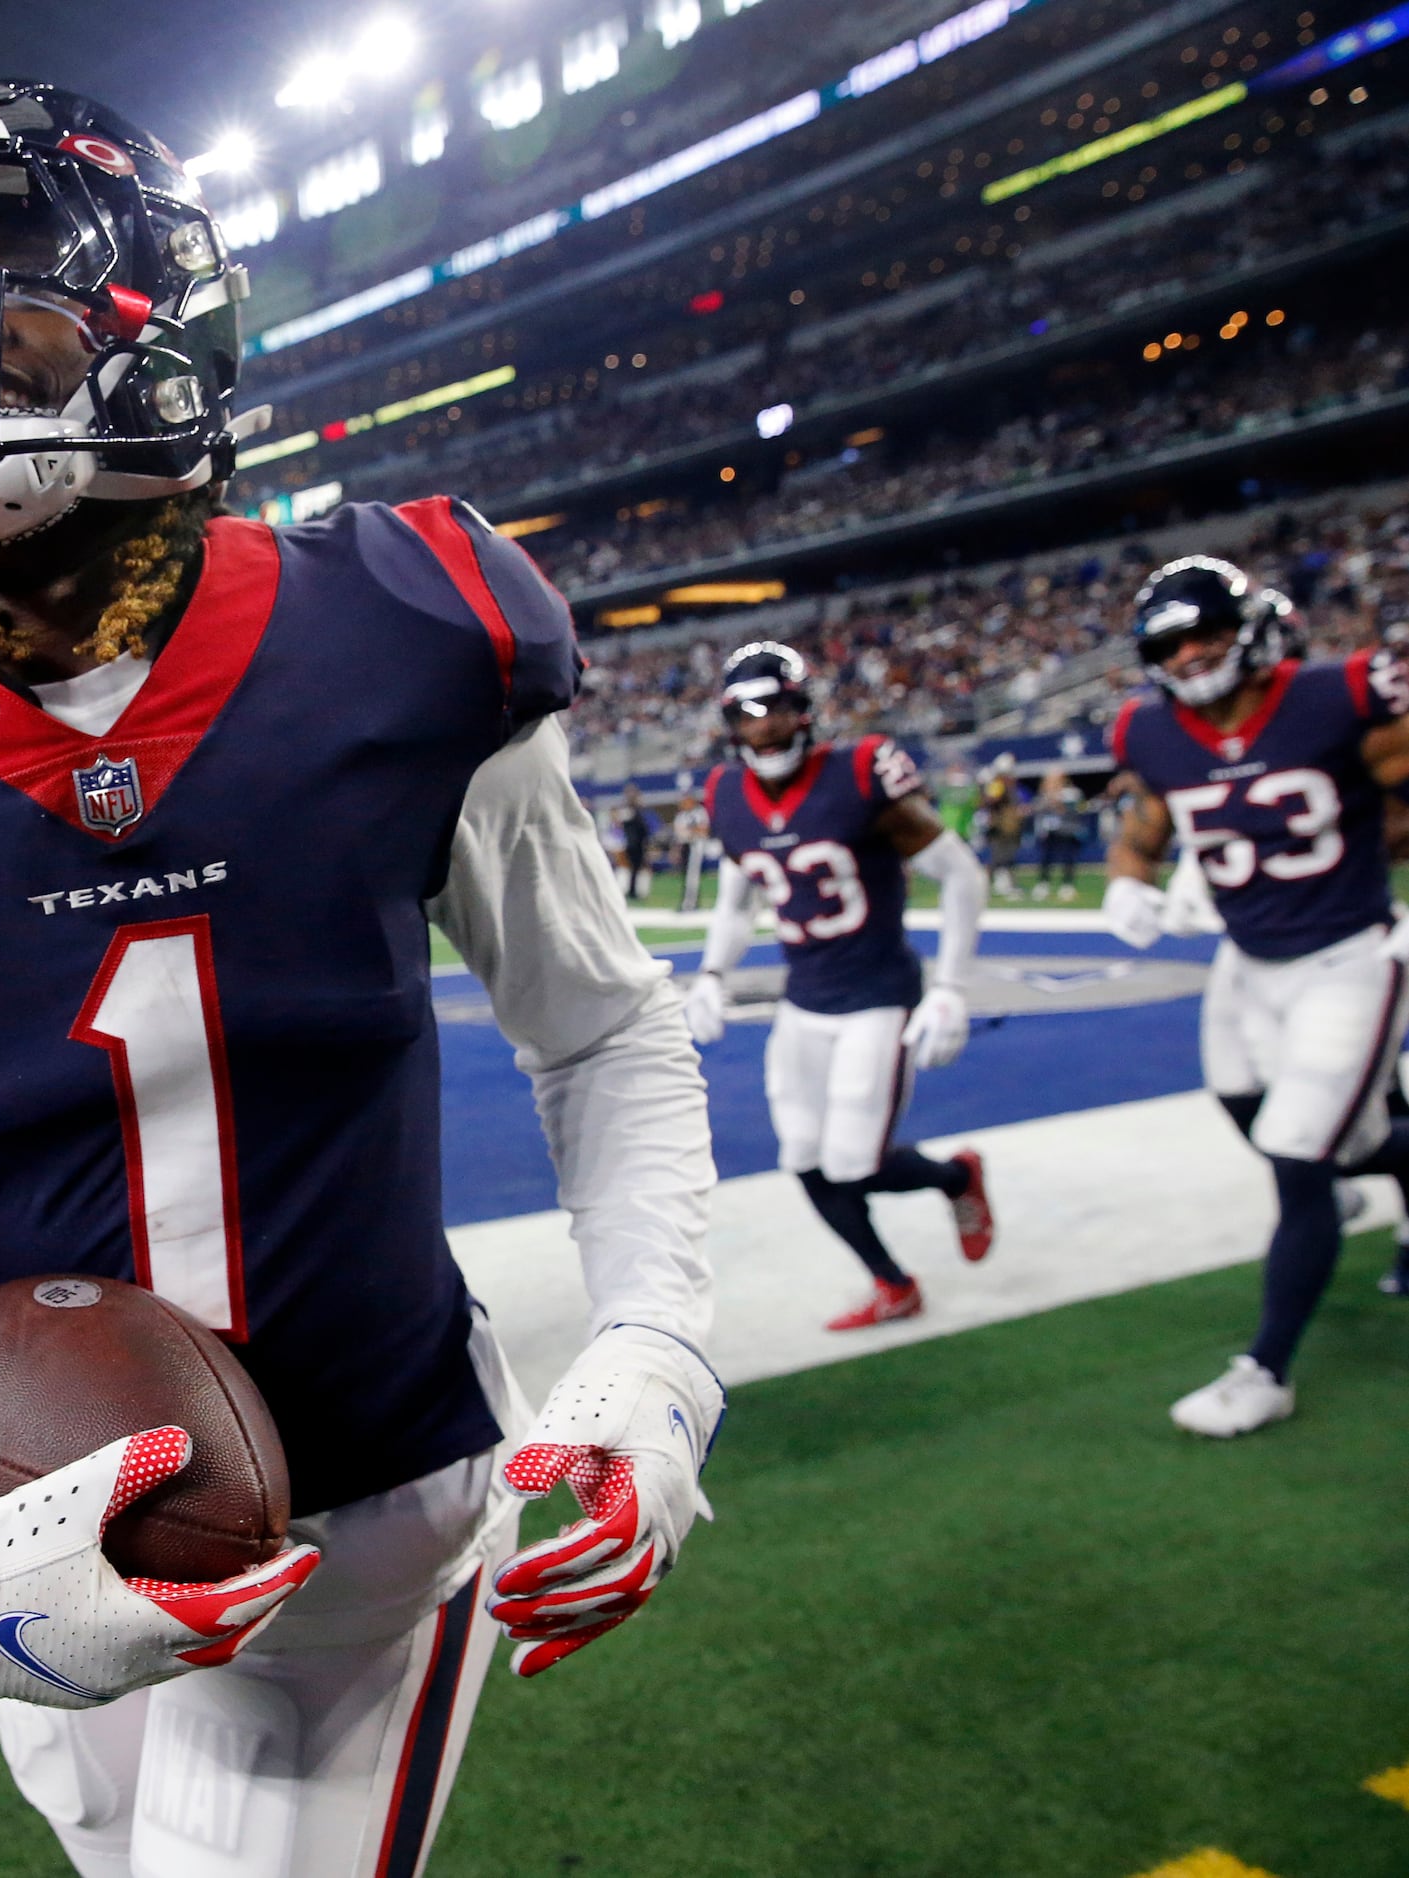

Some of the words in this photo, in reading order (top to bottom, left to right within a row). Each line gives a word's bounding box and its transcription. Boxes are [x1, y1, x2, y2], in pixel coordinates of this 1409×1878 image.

[87, 788, 133, 821] NFL
[1164, 767, 1345, 888] 53
[27, 861, 228, 915] TEXANS
[67, 913, 250, 1344] 1
